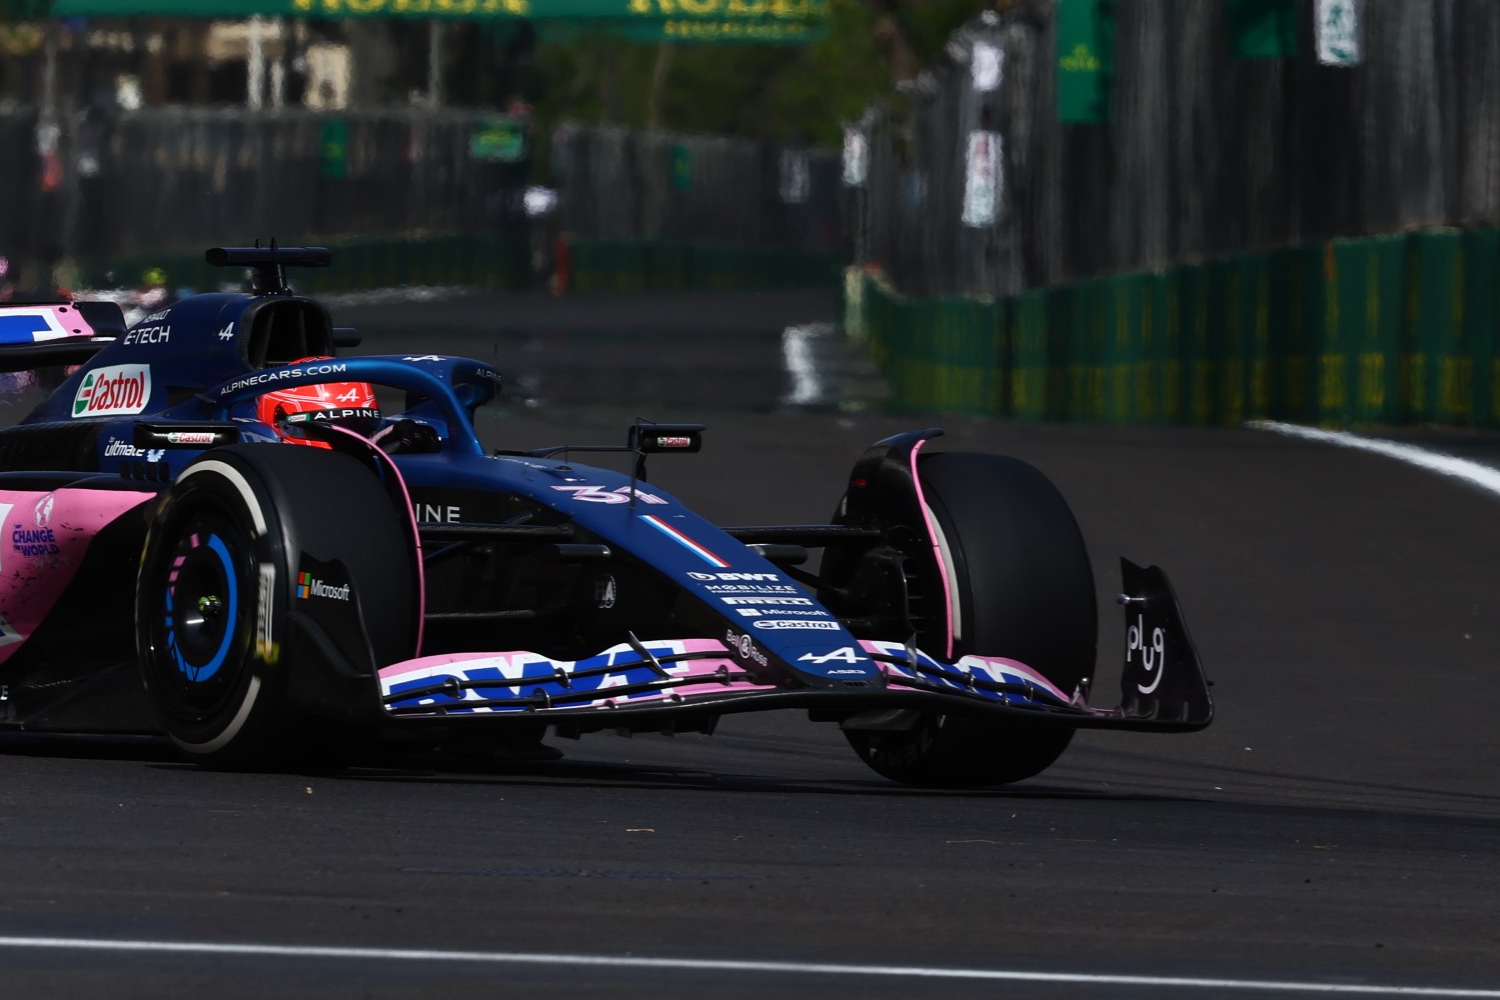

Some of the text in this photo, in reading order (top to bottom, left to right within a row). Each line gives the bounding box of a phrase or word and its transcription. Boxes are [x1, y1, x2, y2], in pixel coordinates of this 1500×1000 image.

[123, 325, 171, 346] E-TECH
[220, 363, 347, 397] ALPINECARS.COM
[88, 370, 146, 411] Castrol
[314, 410, 381, 421] ALPINE
[179, 432, 212, 443] Castrol
[416, 503, 461, 523] INE
[12, 529, 56, 544] CHANGE
[21, 543, 60, 557] WORLD
[715, 572, 780, 582] BWT
[310, 578, 350, 601] Microsoft
[720, 597, 814, 606] PIRELLI
[761, 608, 829, 617] Microsoft
[776, 621, 836, 629] Castrol
[1127, 613, 1165, 694] plug
